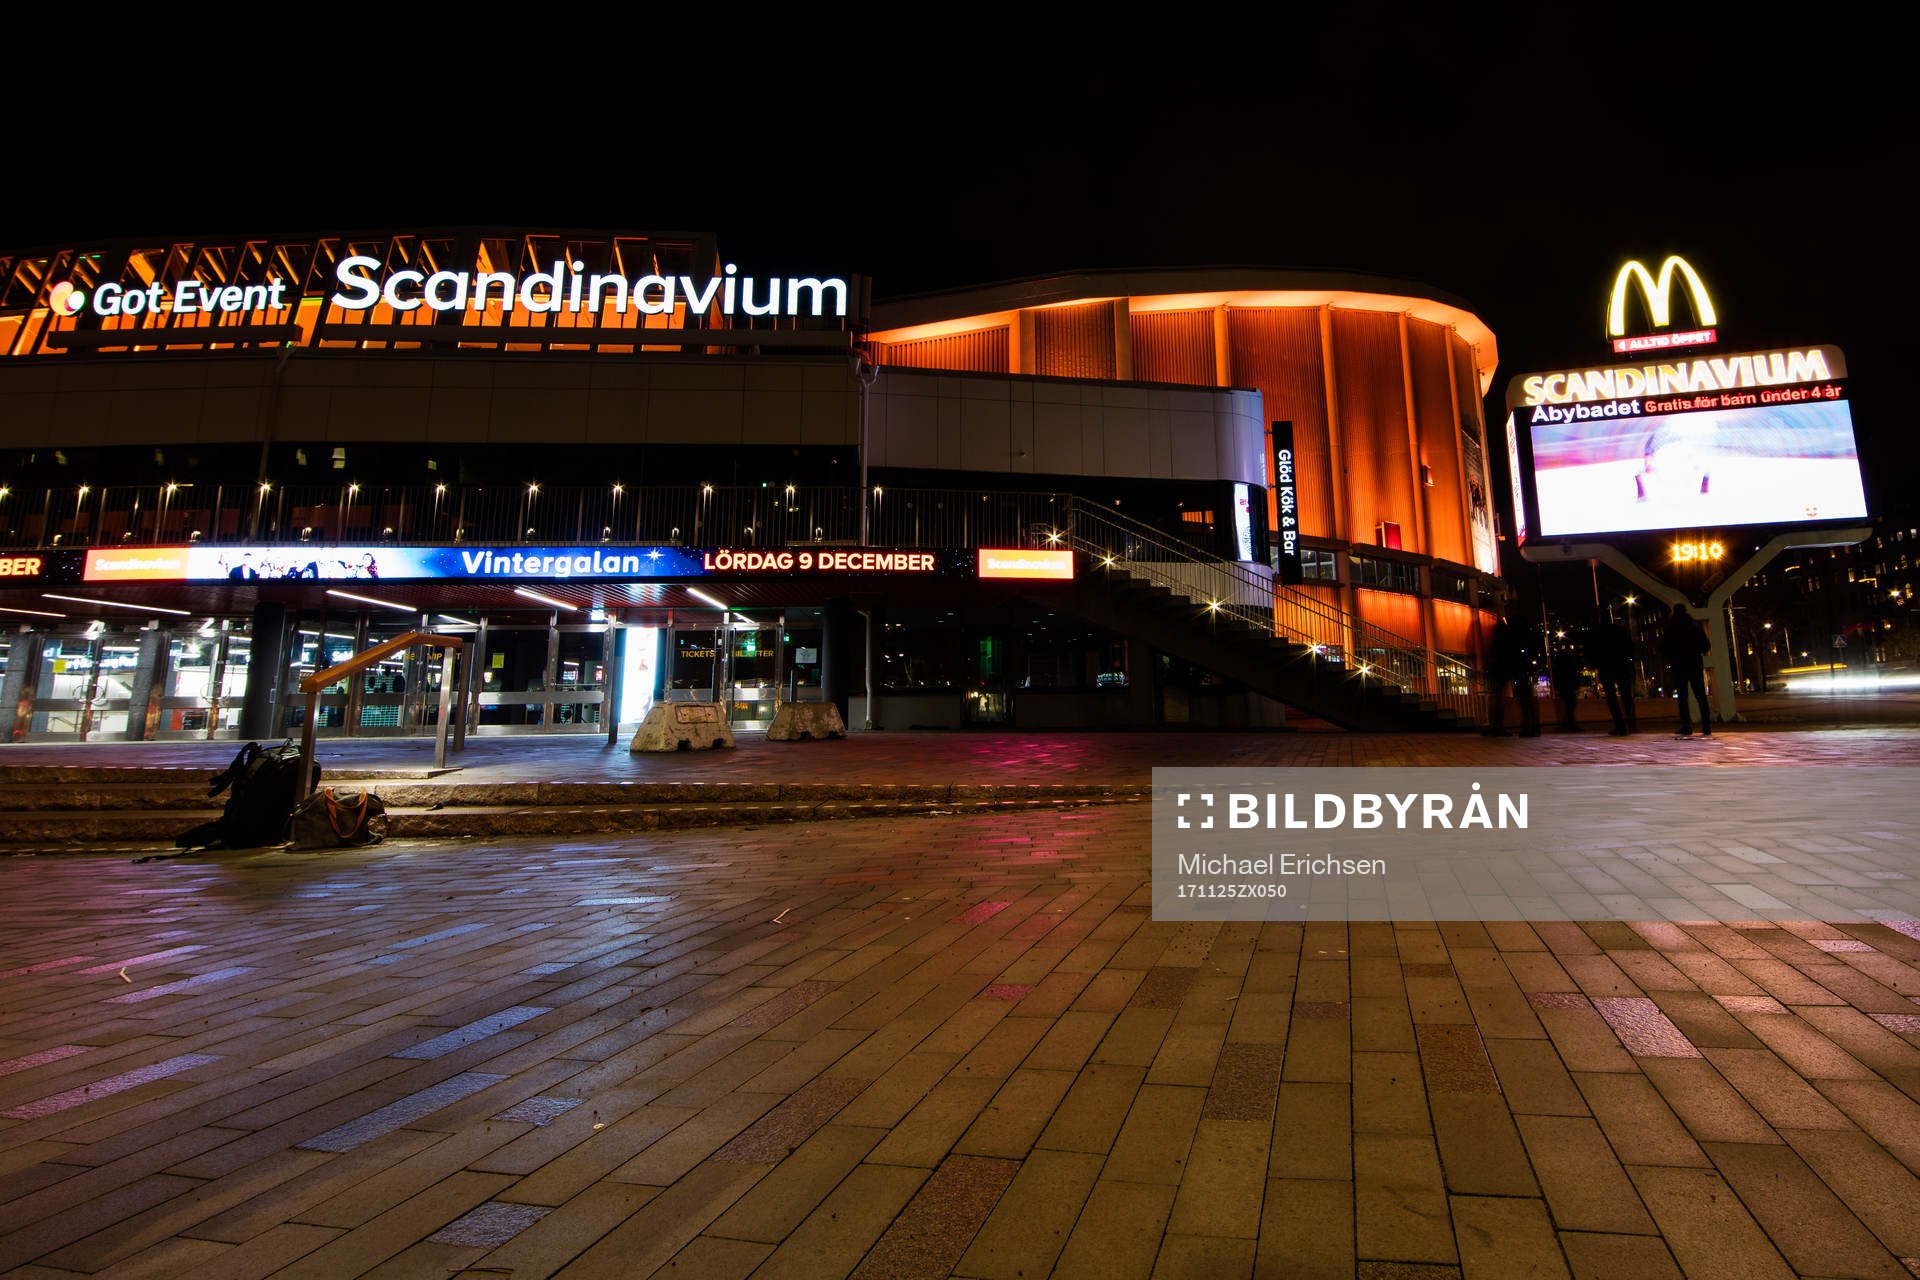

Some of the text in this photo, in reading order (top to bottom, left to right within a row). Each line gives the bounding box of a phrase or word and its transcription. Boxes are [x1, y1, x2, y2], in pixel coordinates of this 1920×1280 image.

[93, 277, 286, 316] Got Event
[331, 255, 849, 317] Scandinavium
[1630, 332, 1712, 350] ALLTID ÖPPET
[1524, 349, 1831, 405] SCANDINAVIUM
[1531, 400, 1641, 424] Åbybadet
[1278, 449, 1297, 556] Glöd Kök & Bar
[461, 550, 639, 577] Vintergalan
[704, 549, 935, 571] LÖRDAG 9 DECEMBER
[1672, 542, 1723, 560] 19:10
[681, 650, 715, 658] TICKETS
